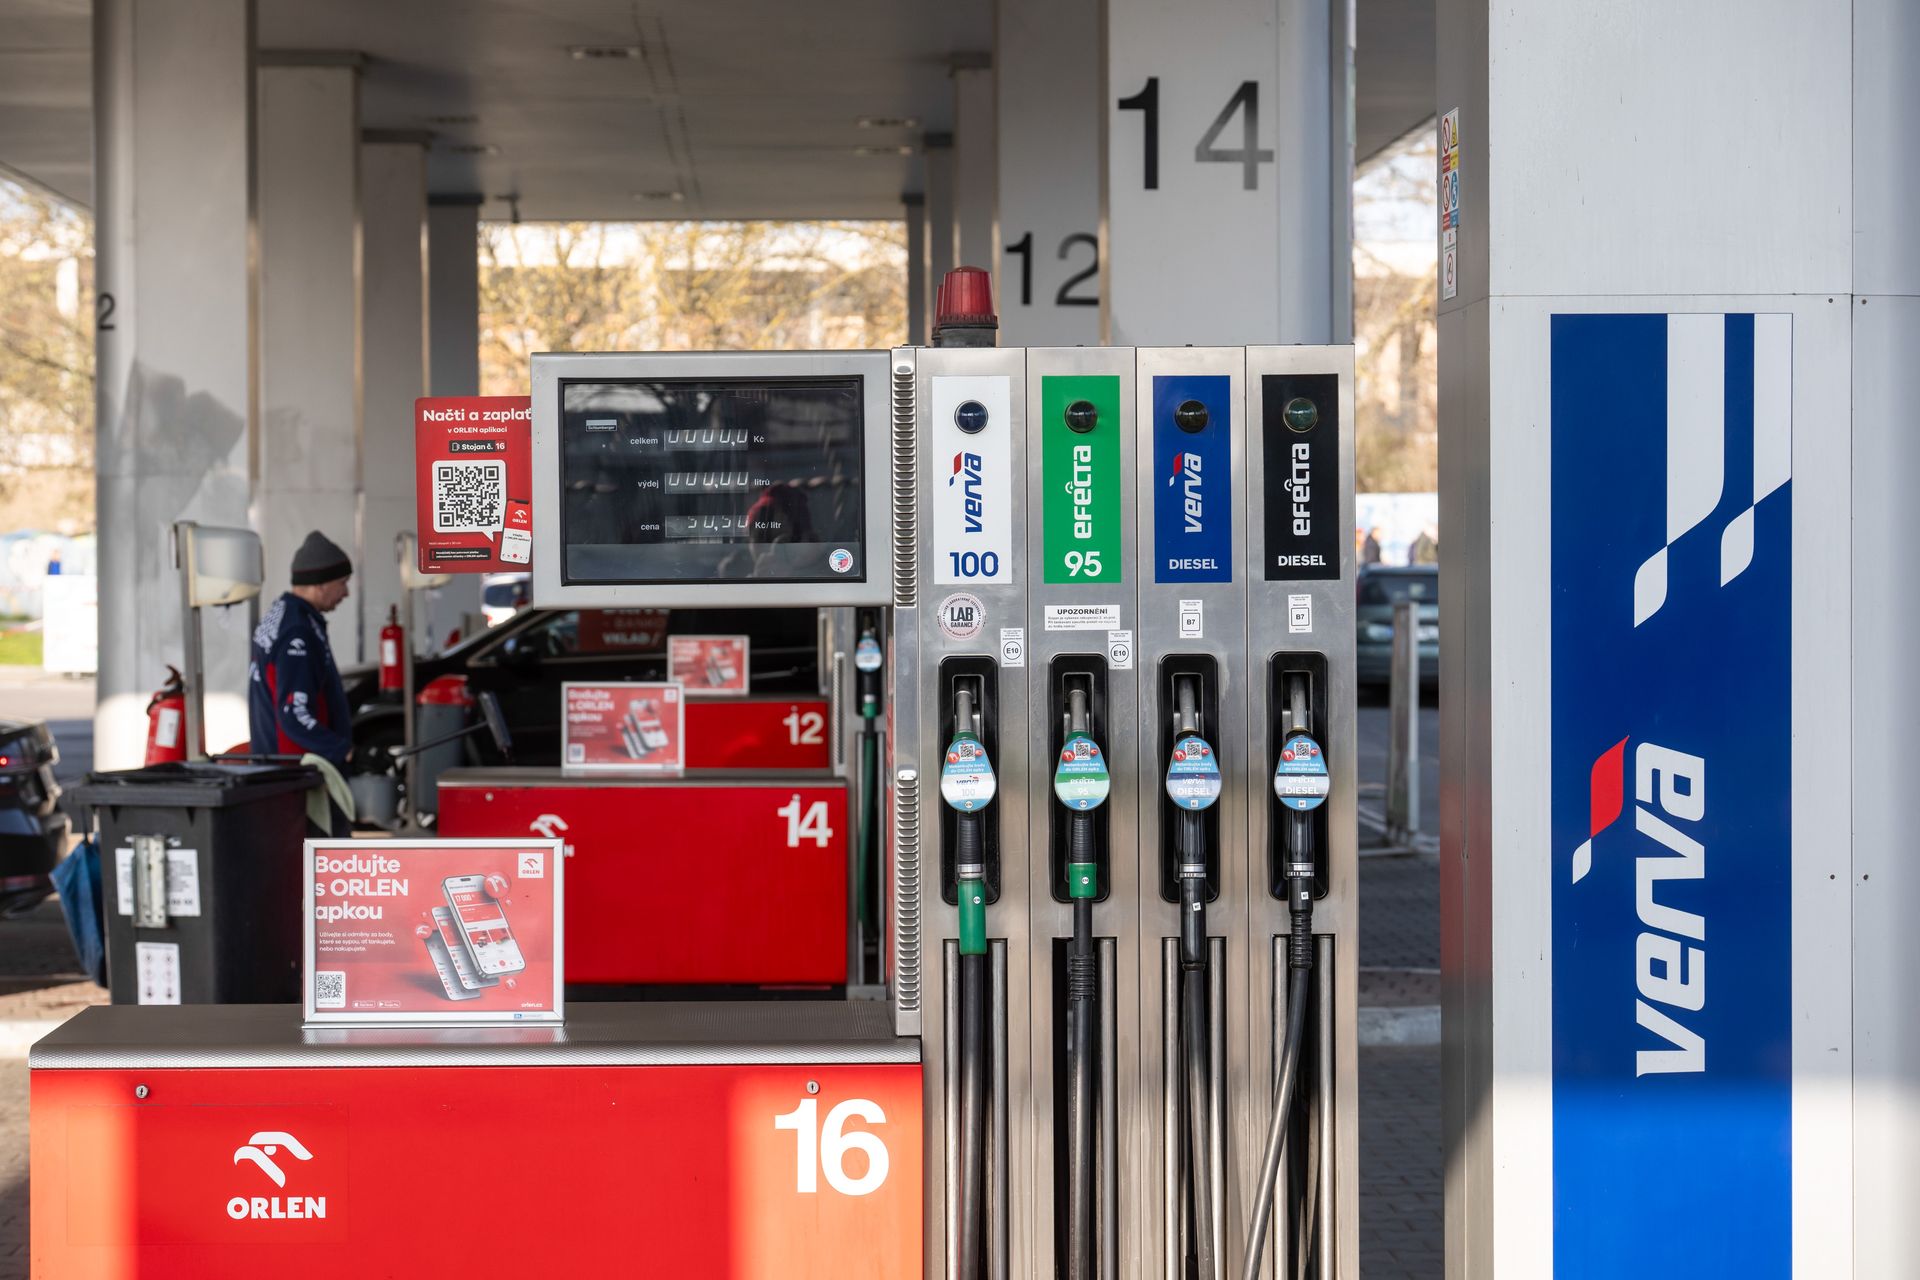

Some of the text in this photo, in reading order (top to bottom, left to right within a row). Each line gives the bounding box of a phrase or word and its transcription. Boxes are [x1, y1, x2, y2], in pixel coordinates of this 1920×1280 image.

[1117, 76, 1275, 191] 14
[1005, 230, 1100, 307] 12
[97, 291, 116, 331] 2
[423, 408, 465, 422] Načti
[469, 411, 479, 421] a
[479, 426, 508, 434] aplikaci
[630, 437, 659, 445] celkem
[753, 435, 765, 443] Kč
[461, 443, 486, 451] Stojan
[486, 442, 494, 451] č.
[637, 480, 659, 489] výdej
[754, 478, 770, 486] litrů
[964, 452, 983, 534] verva
[1184, 452, 1203, 533] verva
[640, 523, 660, 531] cena
[949, 551, 999, 577] 100
[1064, 550, 1102, 577] 95
[1169, 558, 1218, 570] DIESEL
[1277, 555, 1326, 567] DIESEL
[950, 606, 974, 622] LAB
[783, 711, 824, 746] 12
[962, 788, 976, 797] 100
[1177, 787, 1211, 796] DIESEL
[1285, 786, 1319, 795] DIESEL
[777, 798, 833, 848] 14
[315, 854, 401, 877] Bodujte
[315, 879, 409, 897] s ORLEN
[315, 900, 383, 924] apkou
[1635, 742, 1705, 1078] verva
[774, 1098, 889, 1196] 16
[226, 1196, 326, 1220] ORLEN
